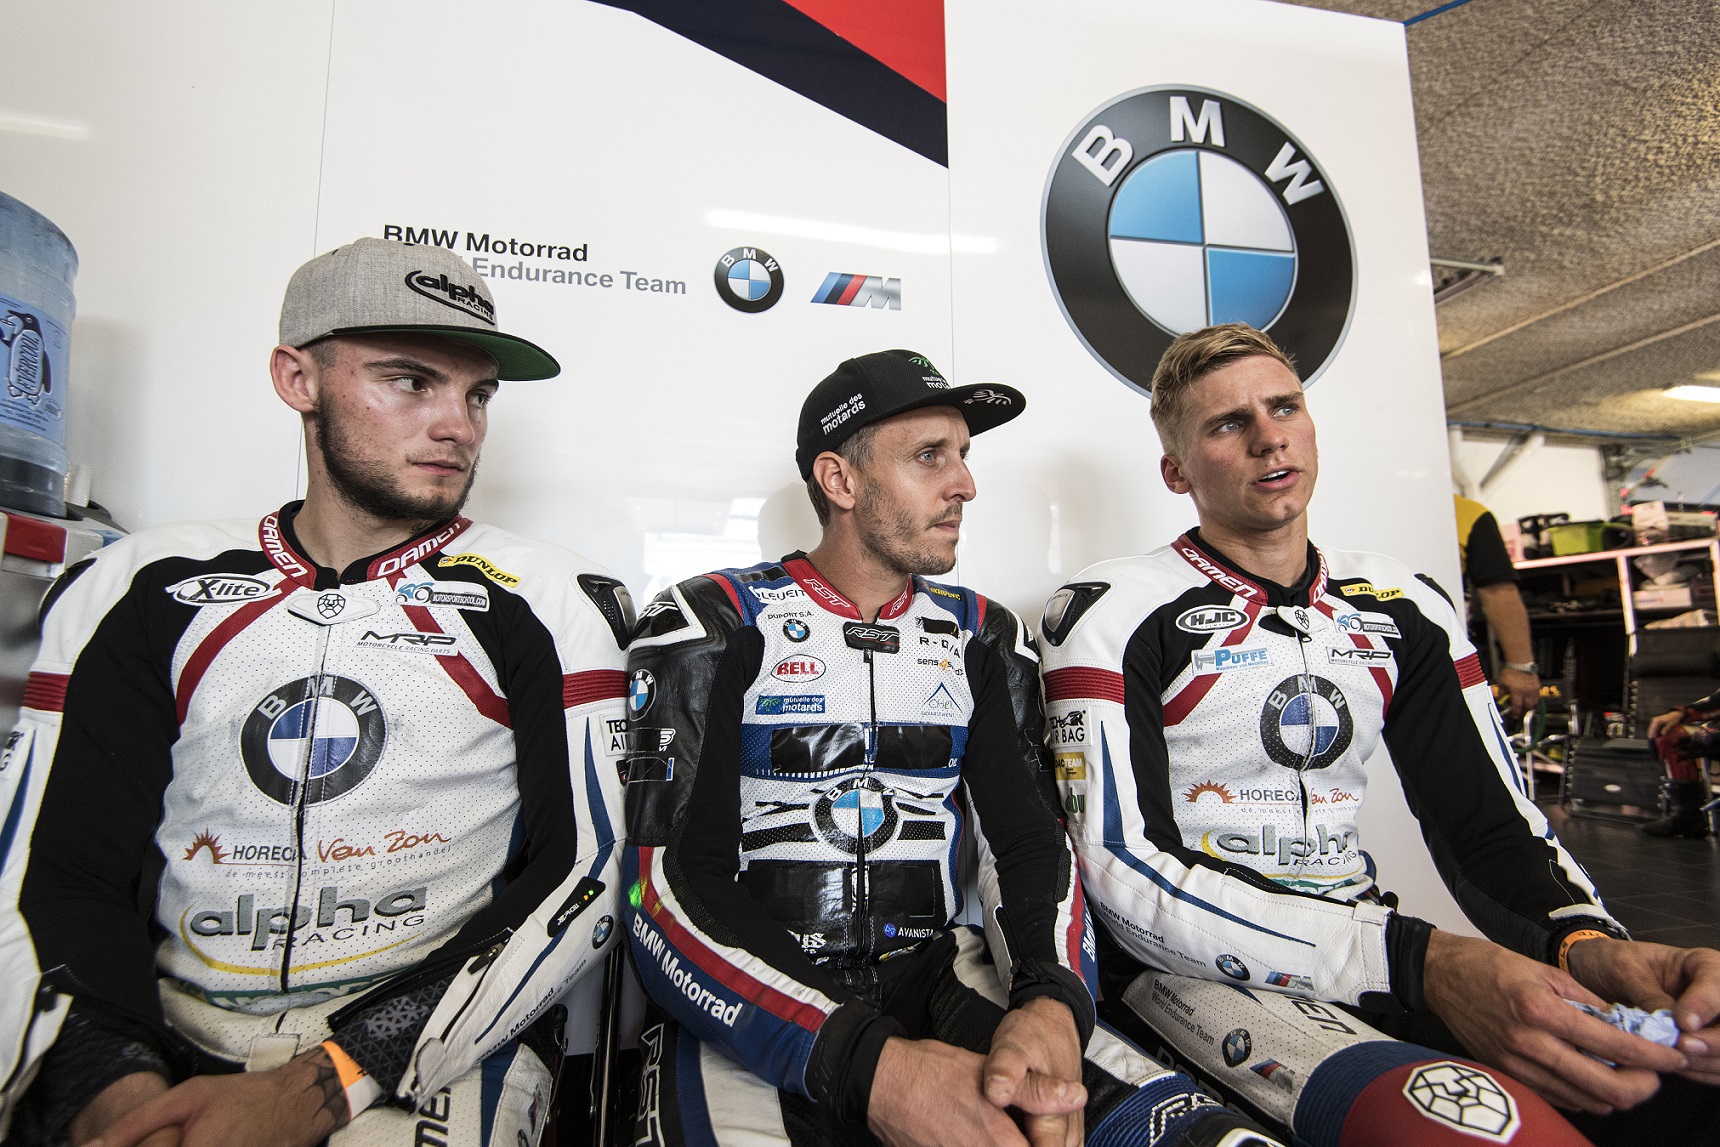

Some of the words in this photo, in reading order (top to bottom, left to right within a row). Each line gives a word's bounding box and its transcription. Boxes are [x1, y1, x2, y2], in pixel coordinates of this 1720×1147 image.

[1071, 96, 1326, 206] BMW
[384, 224, 458, 249] BMW
[466, 232, 588, 261] Motorrad
[721, 248, 779, 273] BMW
[472, 257, 614, 288] Endurance
[619, 270, 687, 294] Team
[415, 273, 494, 315] alpha
[457, 296, 494, 320] RACING
[823, 401, 866, 435] motards
[262, 515, 308, 578] DAMEN
[453, 555, 518, 584] DUNLOP
[1181, 547, 1259, 598] DAMEN
[187, 579, 260, 600] X-lite
[1190, 611, 1236, 627] HJC
[356, 641, 404, 650] MOTORCYCLE
[404, 645, 429, 653] RACING
[845, 626, 900, 642] RST
[777, 661, 820, 675] BELL
[1215, 649, 1268, 667] PUFFE
[257, 676, 380, 720] BMW
[1268, 675, 1346, 711] BMW
[782, 703, 823, 713] motards
[606, 720, 627, 734] TEC
[1062, 727, 1085, 743] BAG
[611, 734, 627, 751] AI
[317, 837, 376, 863] Van
[383, 829, 452, 854] Zon
[190, 886, 428, 951] alpha
[272, 914, 425, 949] RACING
[1121, 916, 1165, 944] Motorrad
[633, 912, 666, 962] BMW
[661, 949, 743, 1028] Motorrad
[1177, 951, 1207, 968] Team
[510, 987, 555, 1037] Motorrad
[1195, 1023, 1215, 1046] Team
